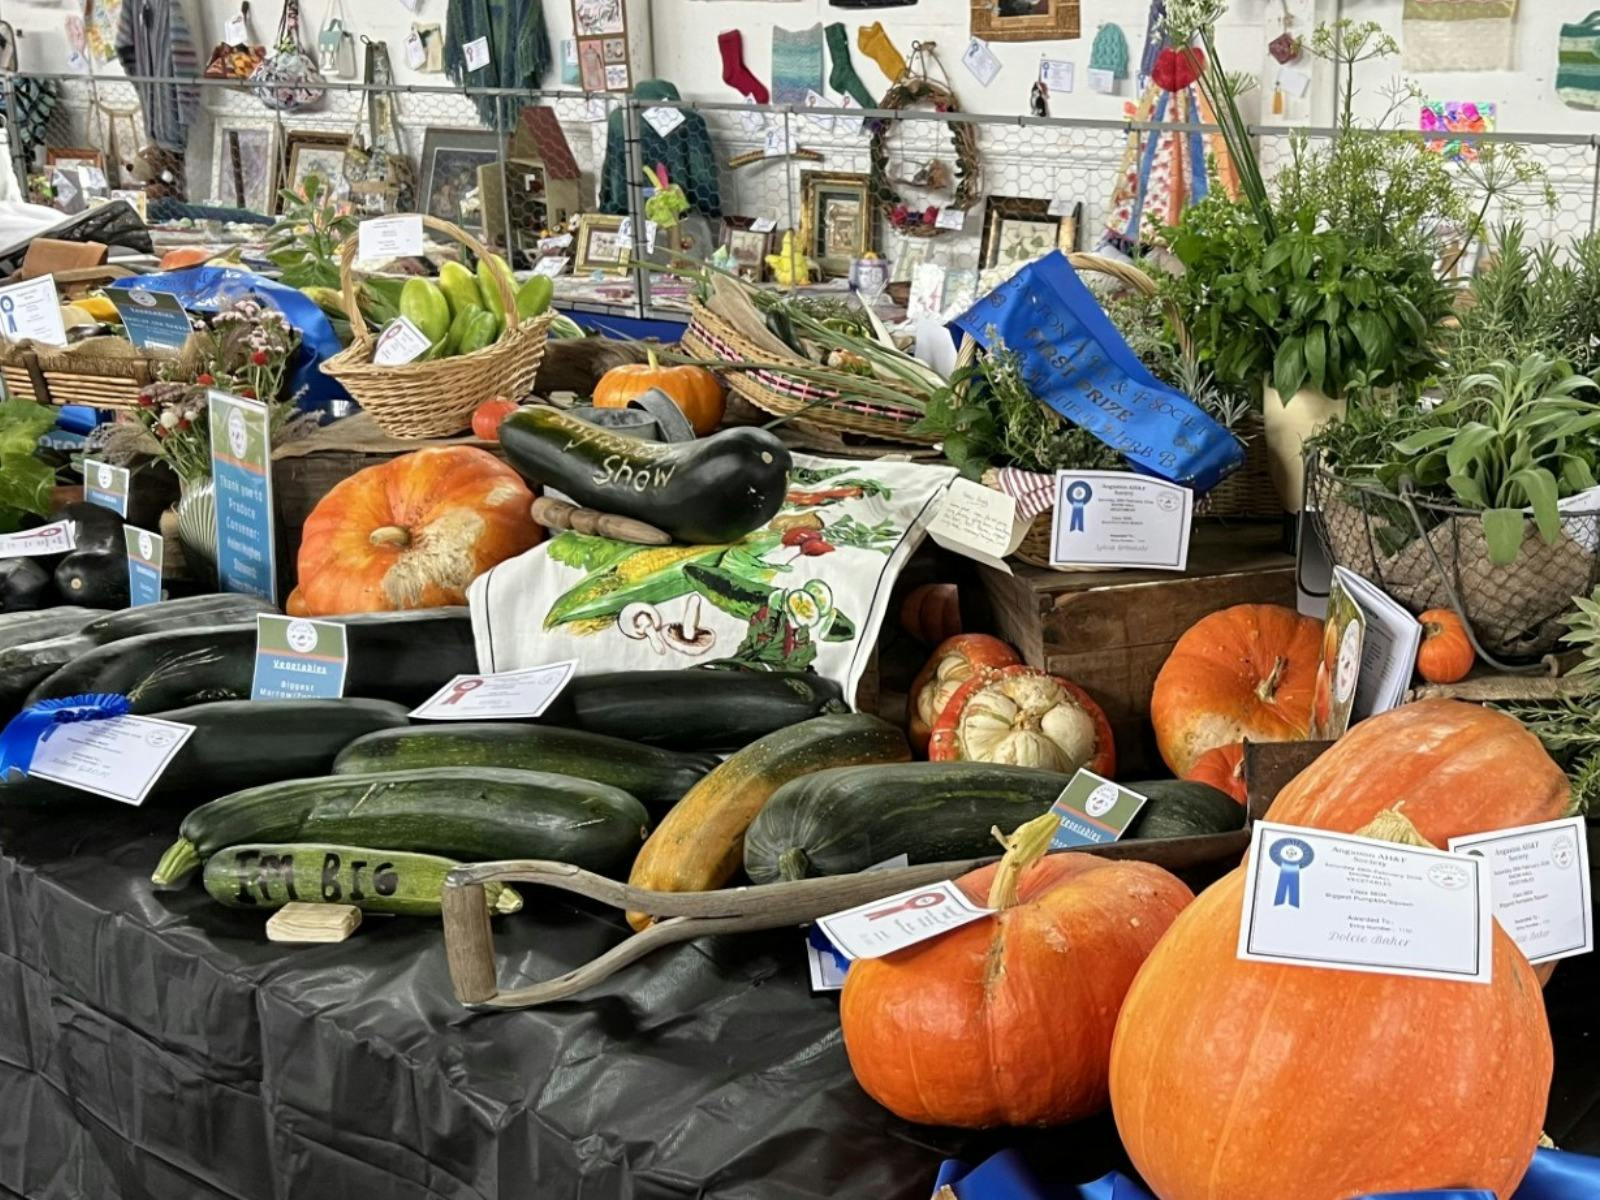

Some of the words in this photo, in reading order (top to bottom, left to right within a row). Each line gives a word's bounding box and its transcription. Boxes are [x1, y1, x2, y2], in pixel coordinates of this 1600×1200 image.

[1077, 379, 1135, 422] PRIZE
[219, 474, 239, 495] Thank
[228, 497, 256, 520] Produce
[273, 659, 328, 675] Vegetables
[280, 680, 315, 692] Biggest
[1060, 815, 1102, 844] Vegetables
[321, 852, 399, 902] BIG
